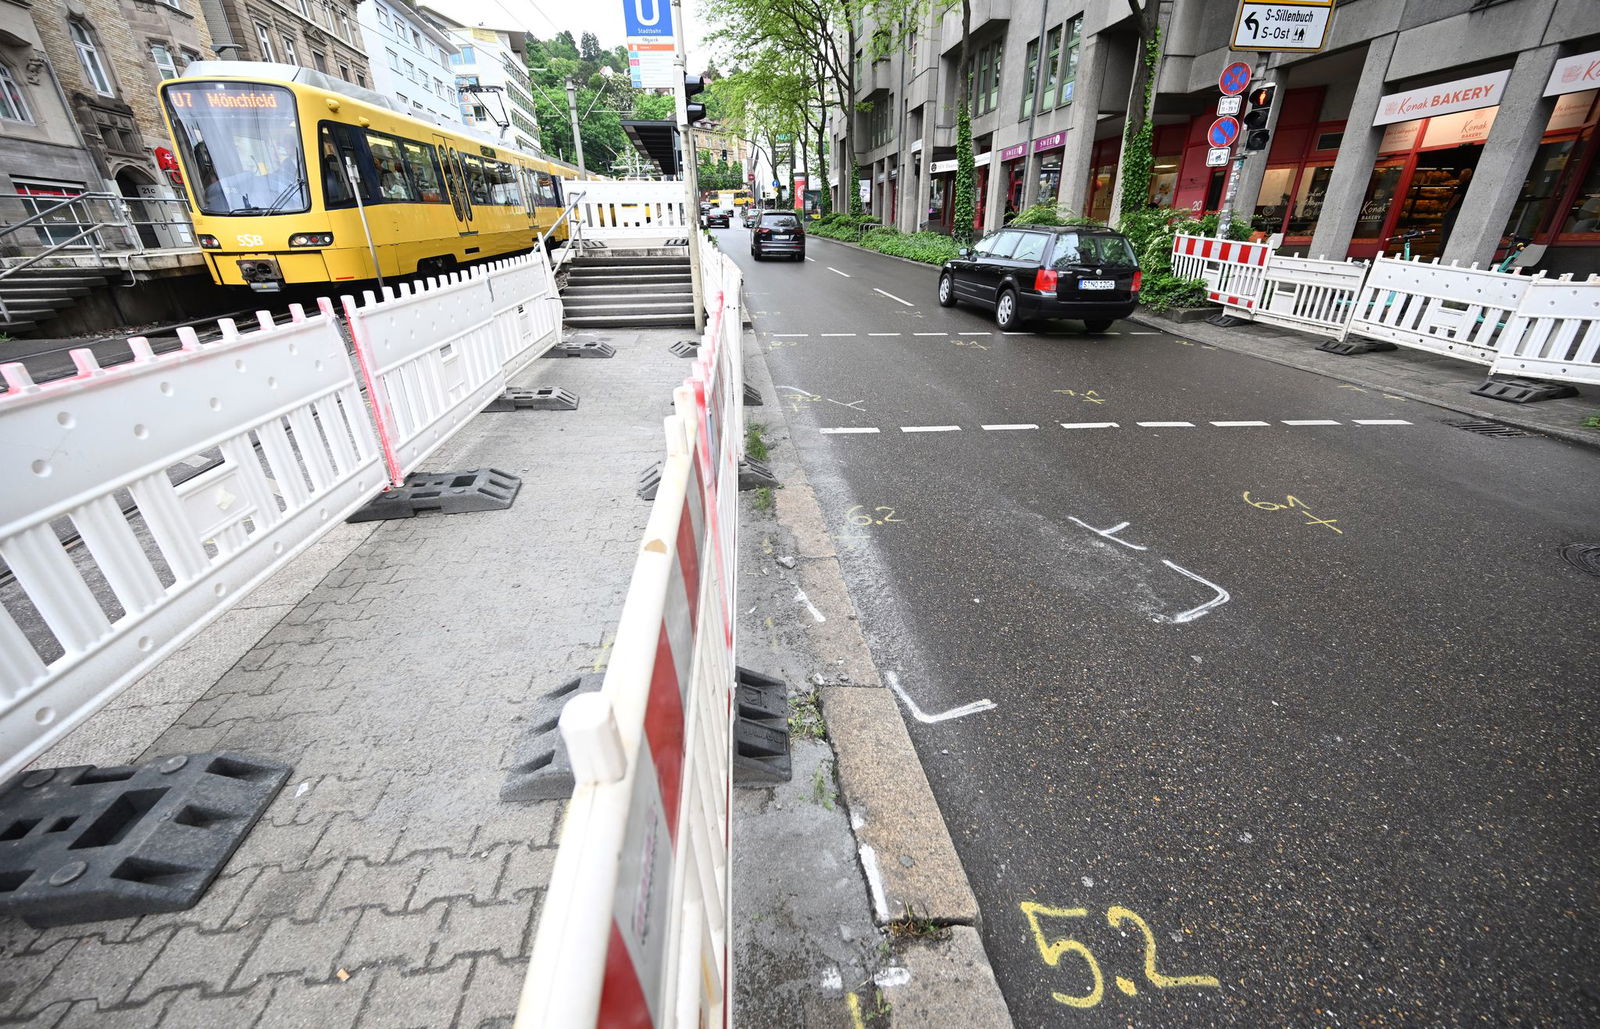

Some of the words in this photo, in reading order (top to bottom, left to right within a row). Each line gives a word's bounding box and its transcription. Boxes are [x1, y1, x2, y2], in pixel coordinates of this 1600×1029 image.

[635, 0, 660, 26] U
[1265, 8, 1314, 22] S-Sillenbuch
[1261, 26, 1290, 39] S-Ost
[171, 92, 193, 107] U7
[206, 92, 278, 108] Mönchfeld
[1397, 97, 1429, 115] Konak
[1430, 84, 1494, 107] BAKERY
[1460, 119, 1488, 134] Konak
[1192, 200, 1203, 211] 20
[236, 233, 264, 247] SSB
[847, 504, 907, 526] 6.2
[1019, 901, 1220, 1008] 5.2
